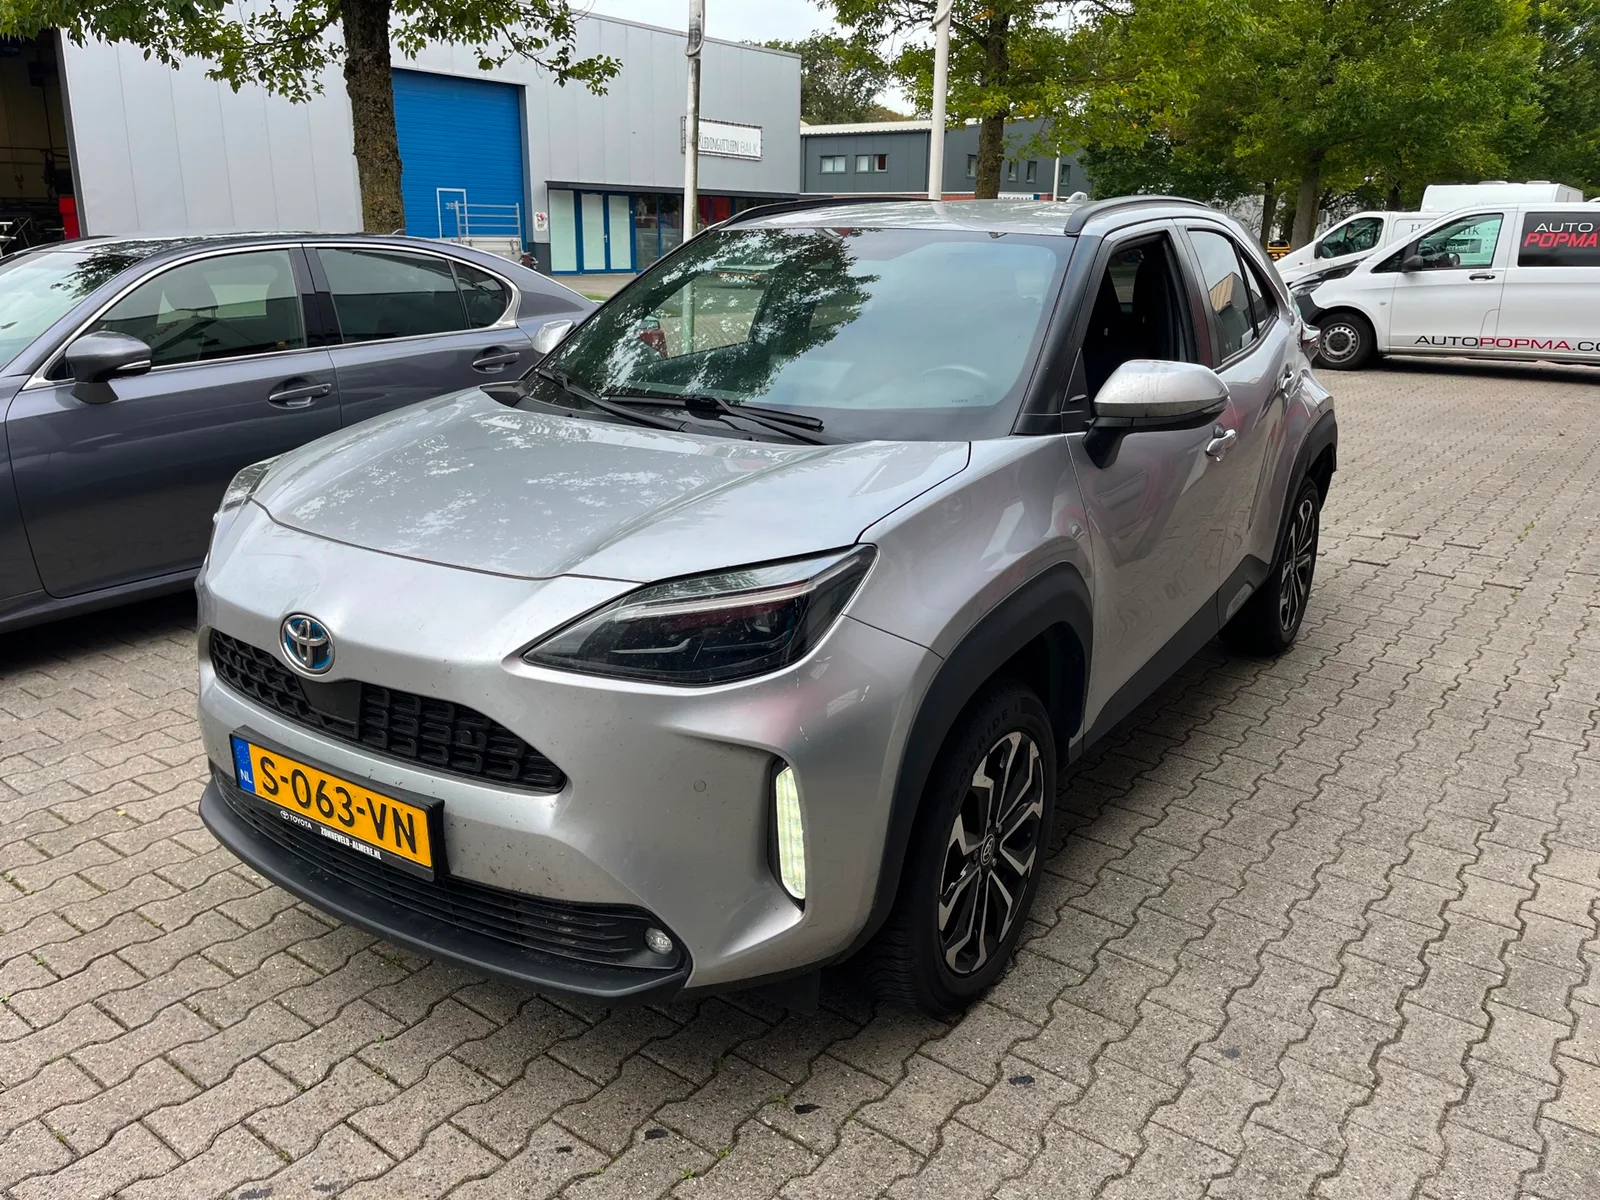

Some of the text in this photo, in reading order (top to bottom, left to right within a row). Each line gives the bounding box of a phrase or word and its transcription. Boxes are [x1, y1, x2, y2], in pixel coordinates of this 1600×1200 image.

[1534, 222, 1594, 233] AUTO
[1523, 232, 1599, 248] POPMA
[1414, 335, 1600, 352] AUTOPOPMA.C
[240, 769, 253, 784] NL
[259, 756, 417, 854] S-063-VN
[289, 814, 313, 830] TOYOTA
